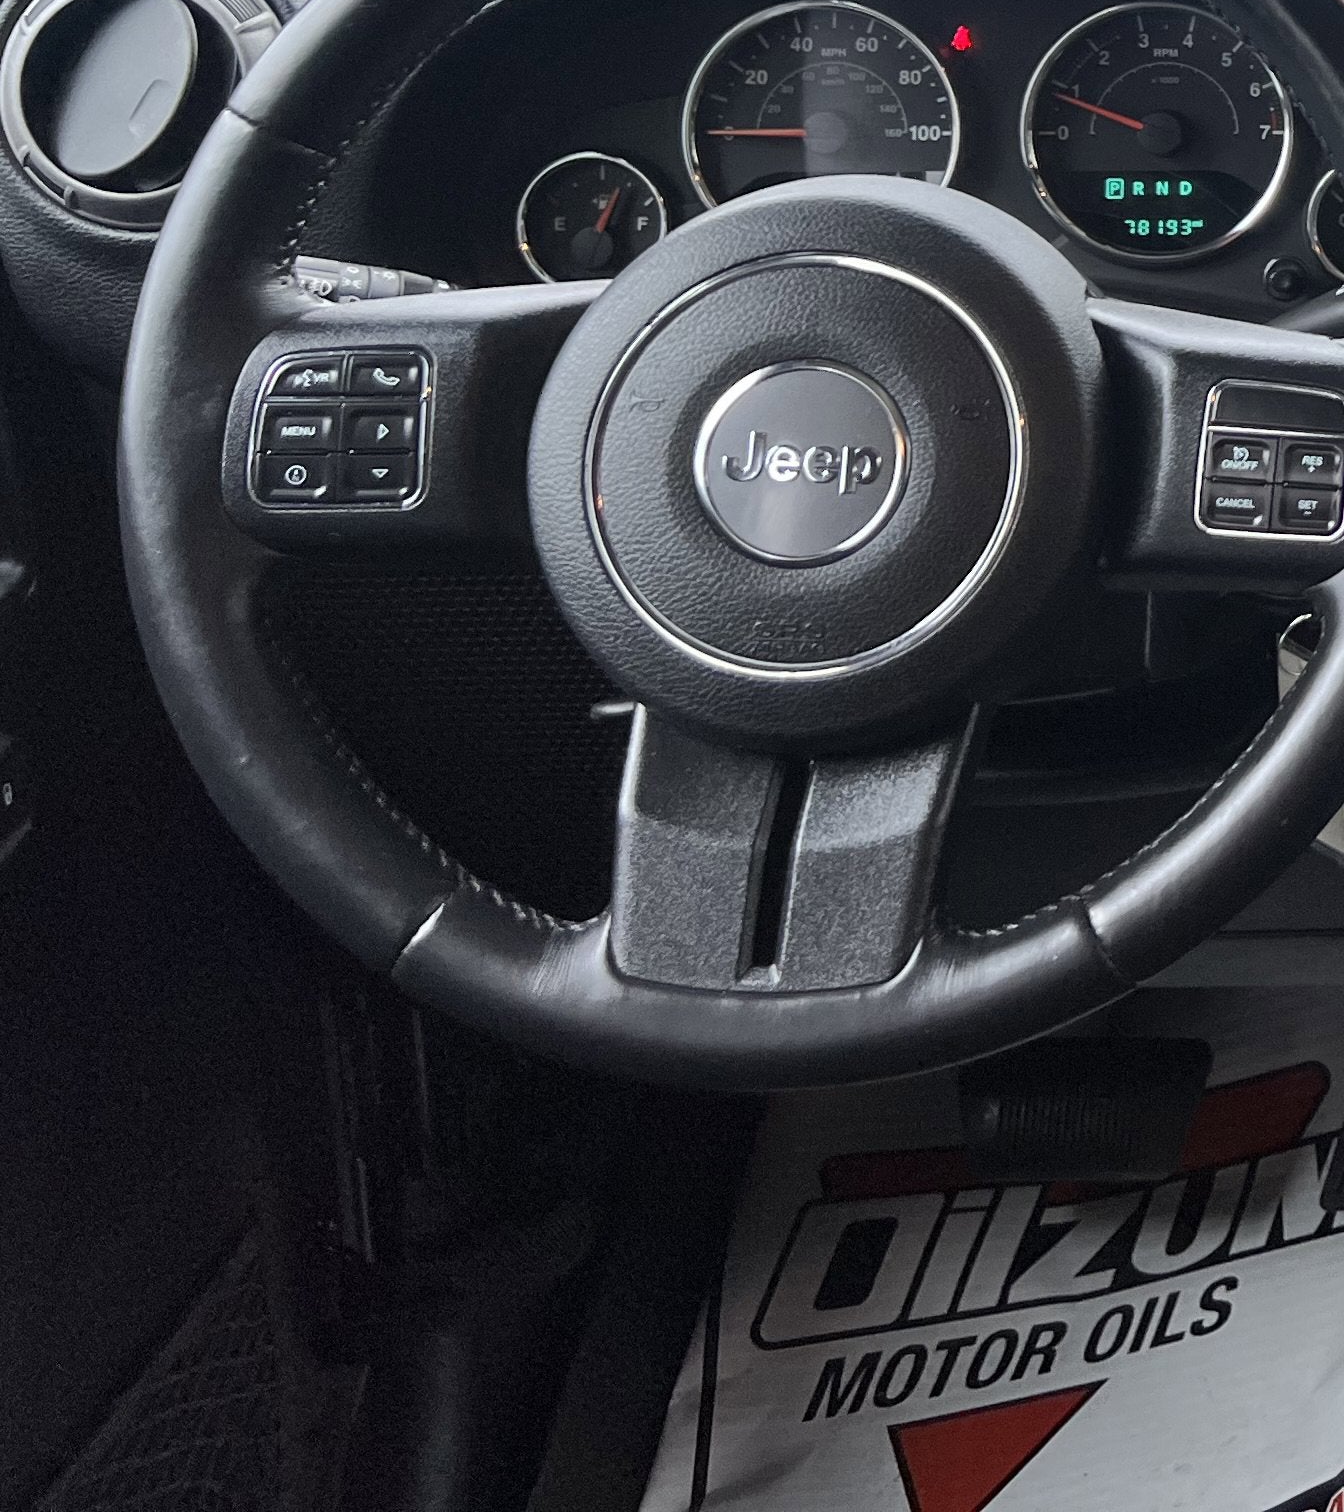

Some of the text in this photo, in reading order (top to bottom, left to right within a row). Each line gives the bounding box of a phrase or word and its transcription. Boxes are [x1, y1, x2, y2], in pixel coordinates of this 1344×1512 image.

[790, 37, 879, 53] 40 60
[1138, 34, 1194, 48] 3 4
[821, 48, 847, 57] MPH
[1099, 51, 1110, 66] 2
[1153, 48, 1179, 58] RPM
[1221, 53, 1232, 67] 5
[745, 70, 768, 85] 20
[899, 70, 922, 85] 80
[1249, 83, 1261, 98] 6
[909, 125, 941, 141] 100
[1057, 126, 1069, 141] 0
[1259, 125, 1271, 140] 7
[1132, 181, 1145, 196] R
[1156, 181, 1169, 196] N
[1180, 181, 1193, 196] D
[554, 217, 566, 231] E
[636, 216, 649, 231] F
[280, 426, 316, 437] MENU
[722, 430, 882, 496] Jeep
[1302, 455, 1324, 466] RES
[1215, 497, 1256, 509] CANCEL
[1297, 500, 1319, 510] SET
[801, 1275, 1239, 1423] MOTOR OILS
